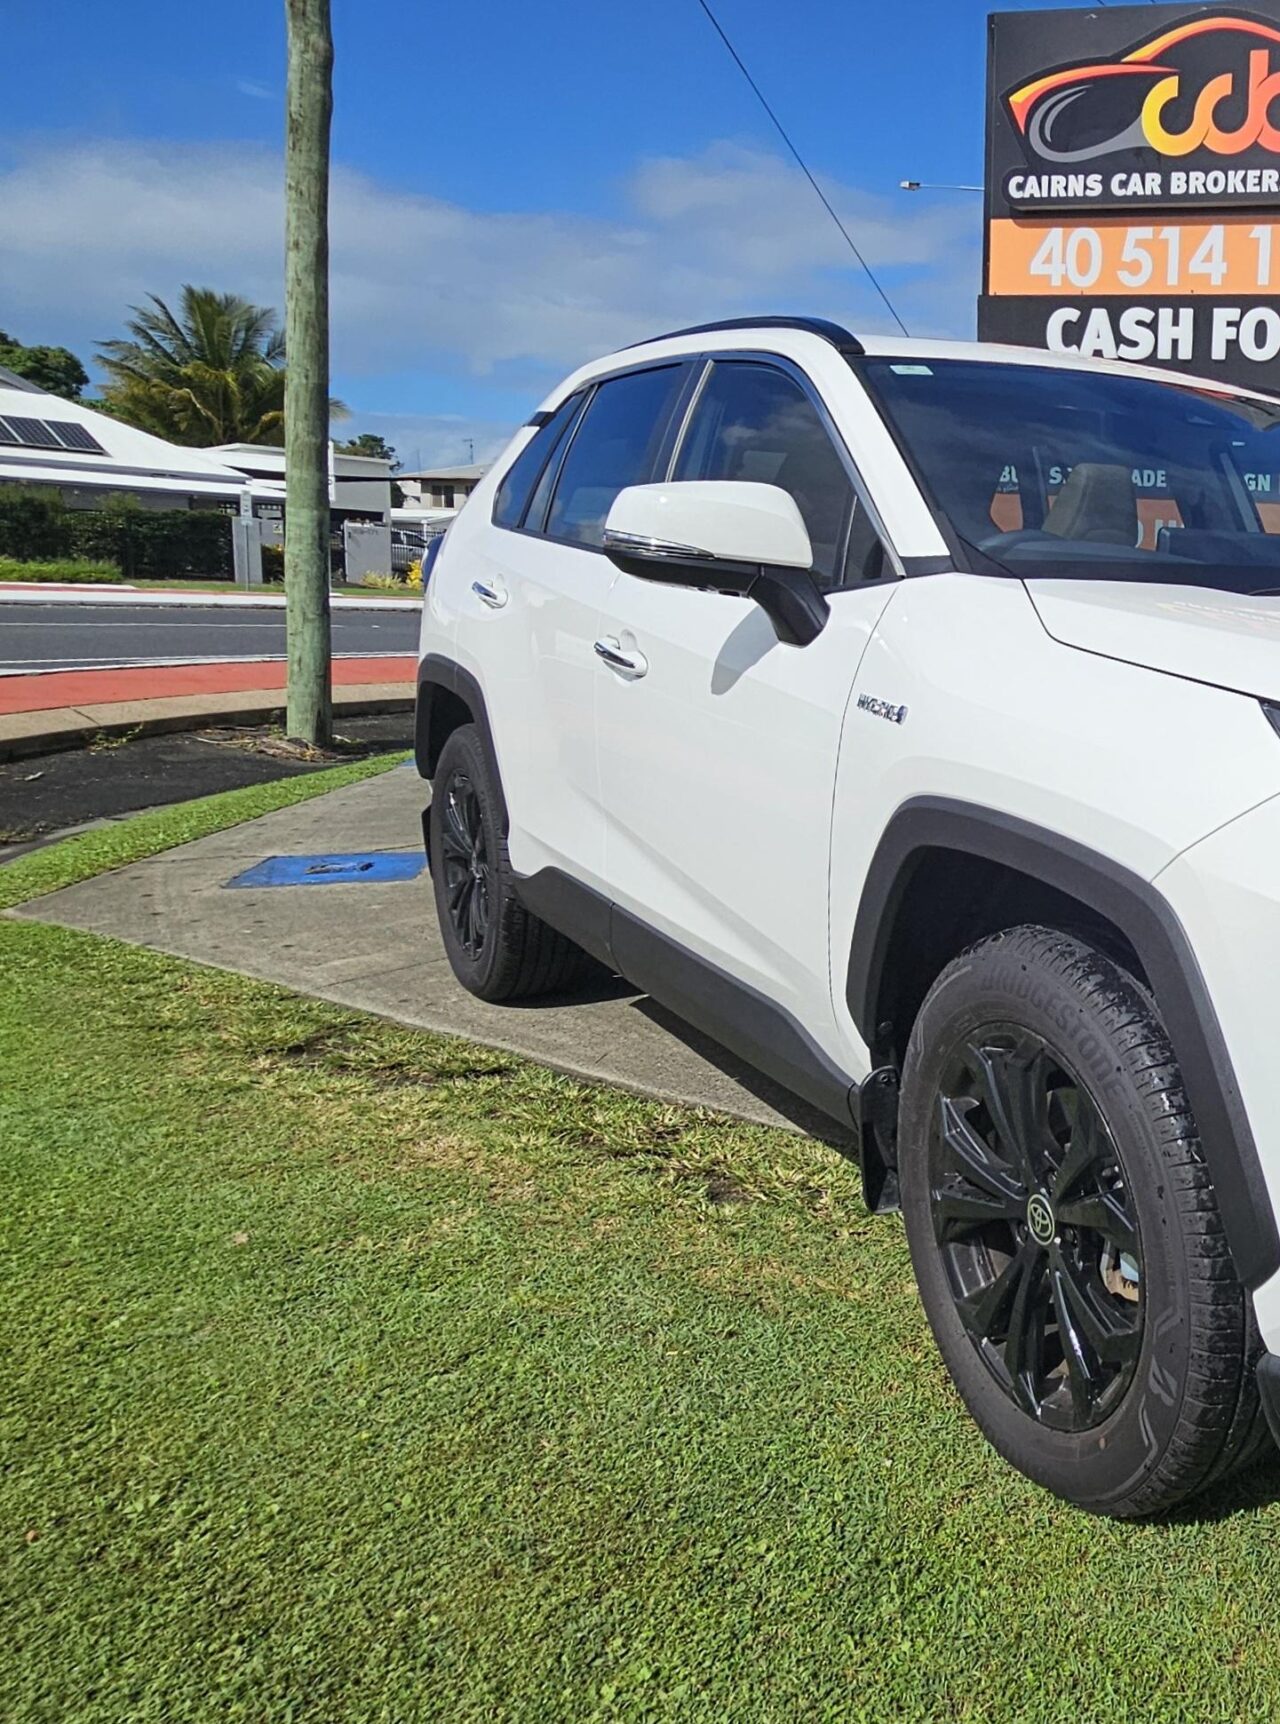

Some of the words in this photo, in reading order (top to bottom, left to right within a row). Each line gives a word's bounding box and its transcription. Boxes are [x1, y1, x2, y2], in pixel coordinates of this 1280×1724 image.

[1007, 174, 1102, 199] CAIRNS
[1110, 172, 1162, 197] CAR
[1029, 227, 1102, 288] 40
[1116, 224, 1228, 287] 514
[1046, 307, 1194, 361] CASH
